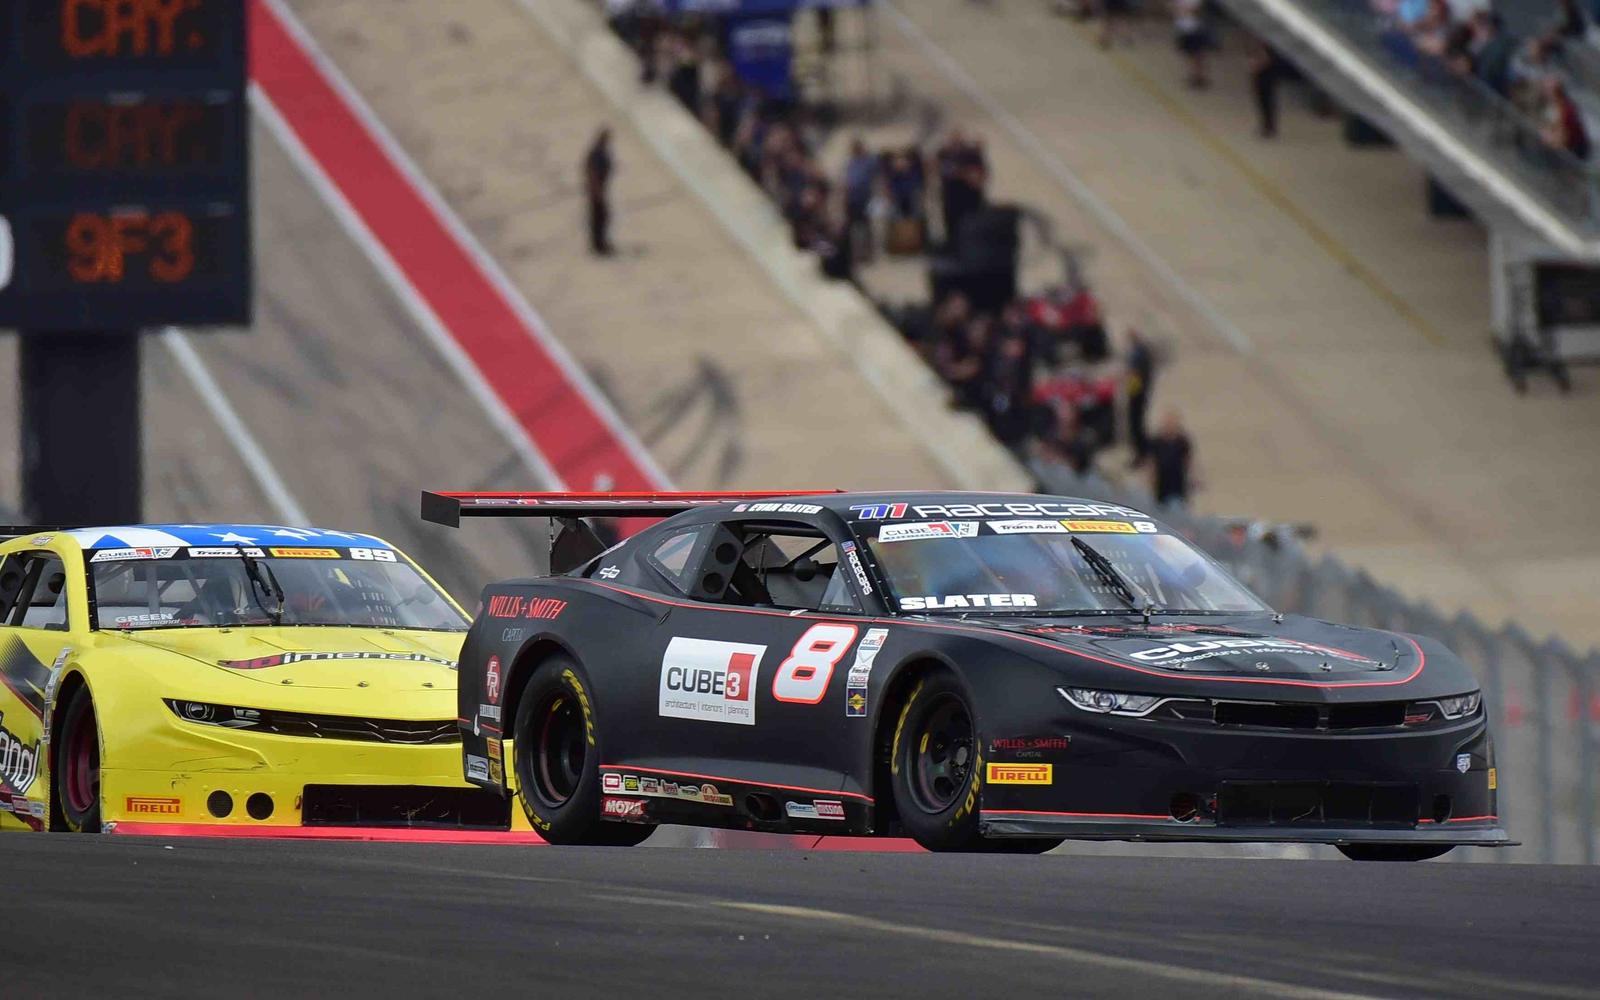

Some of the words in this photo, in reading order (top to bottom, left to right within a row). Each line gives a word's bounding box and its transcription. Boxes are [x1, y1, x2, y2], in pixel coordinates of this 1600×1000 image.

[350, 548, 398, 562] 89
[900, 593, 1038, 611] SLATER
[115, 613, 174, 624] GREEN
[773, 623, 858, 705] 8
[667, 666, 742, 697] CUBE3
[992, 739, 1025, 749] WILLIS
[1034, 740, 1068, 749] SMITH
[991, 766, 1048, 781] PIRELLI
[127, 798, 180, 814] PIRELLI
